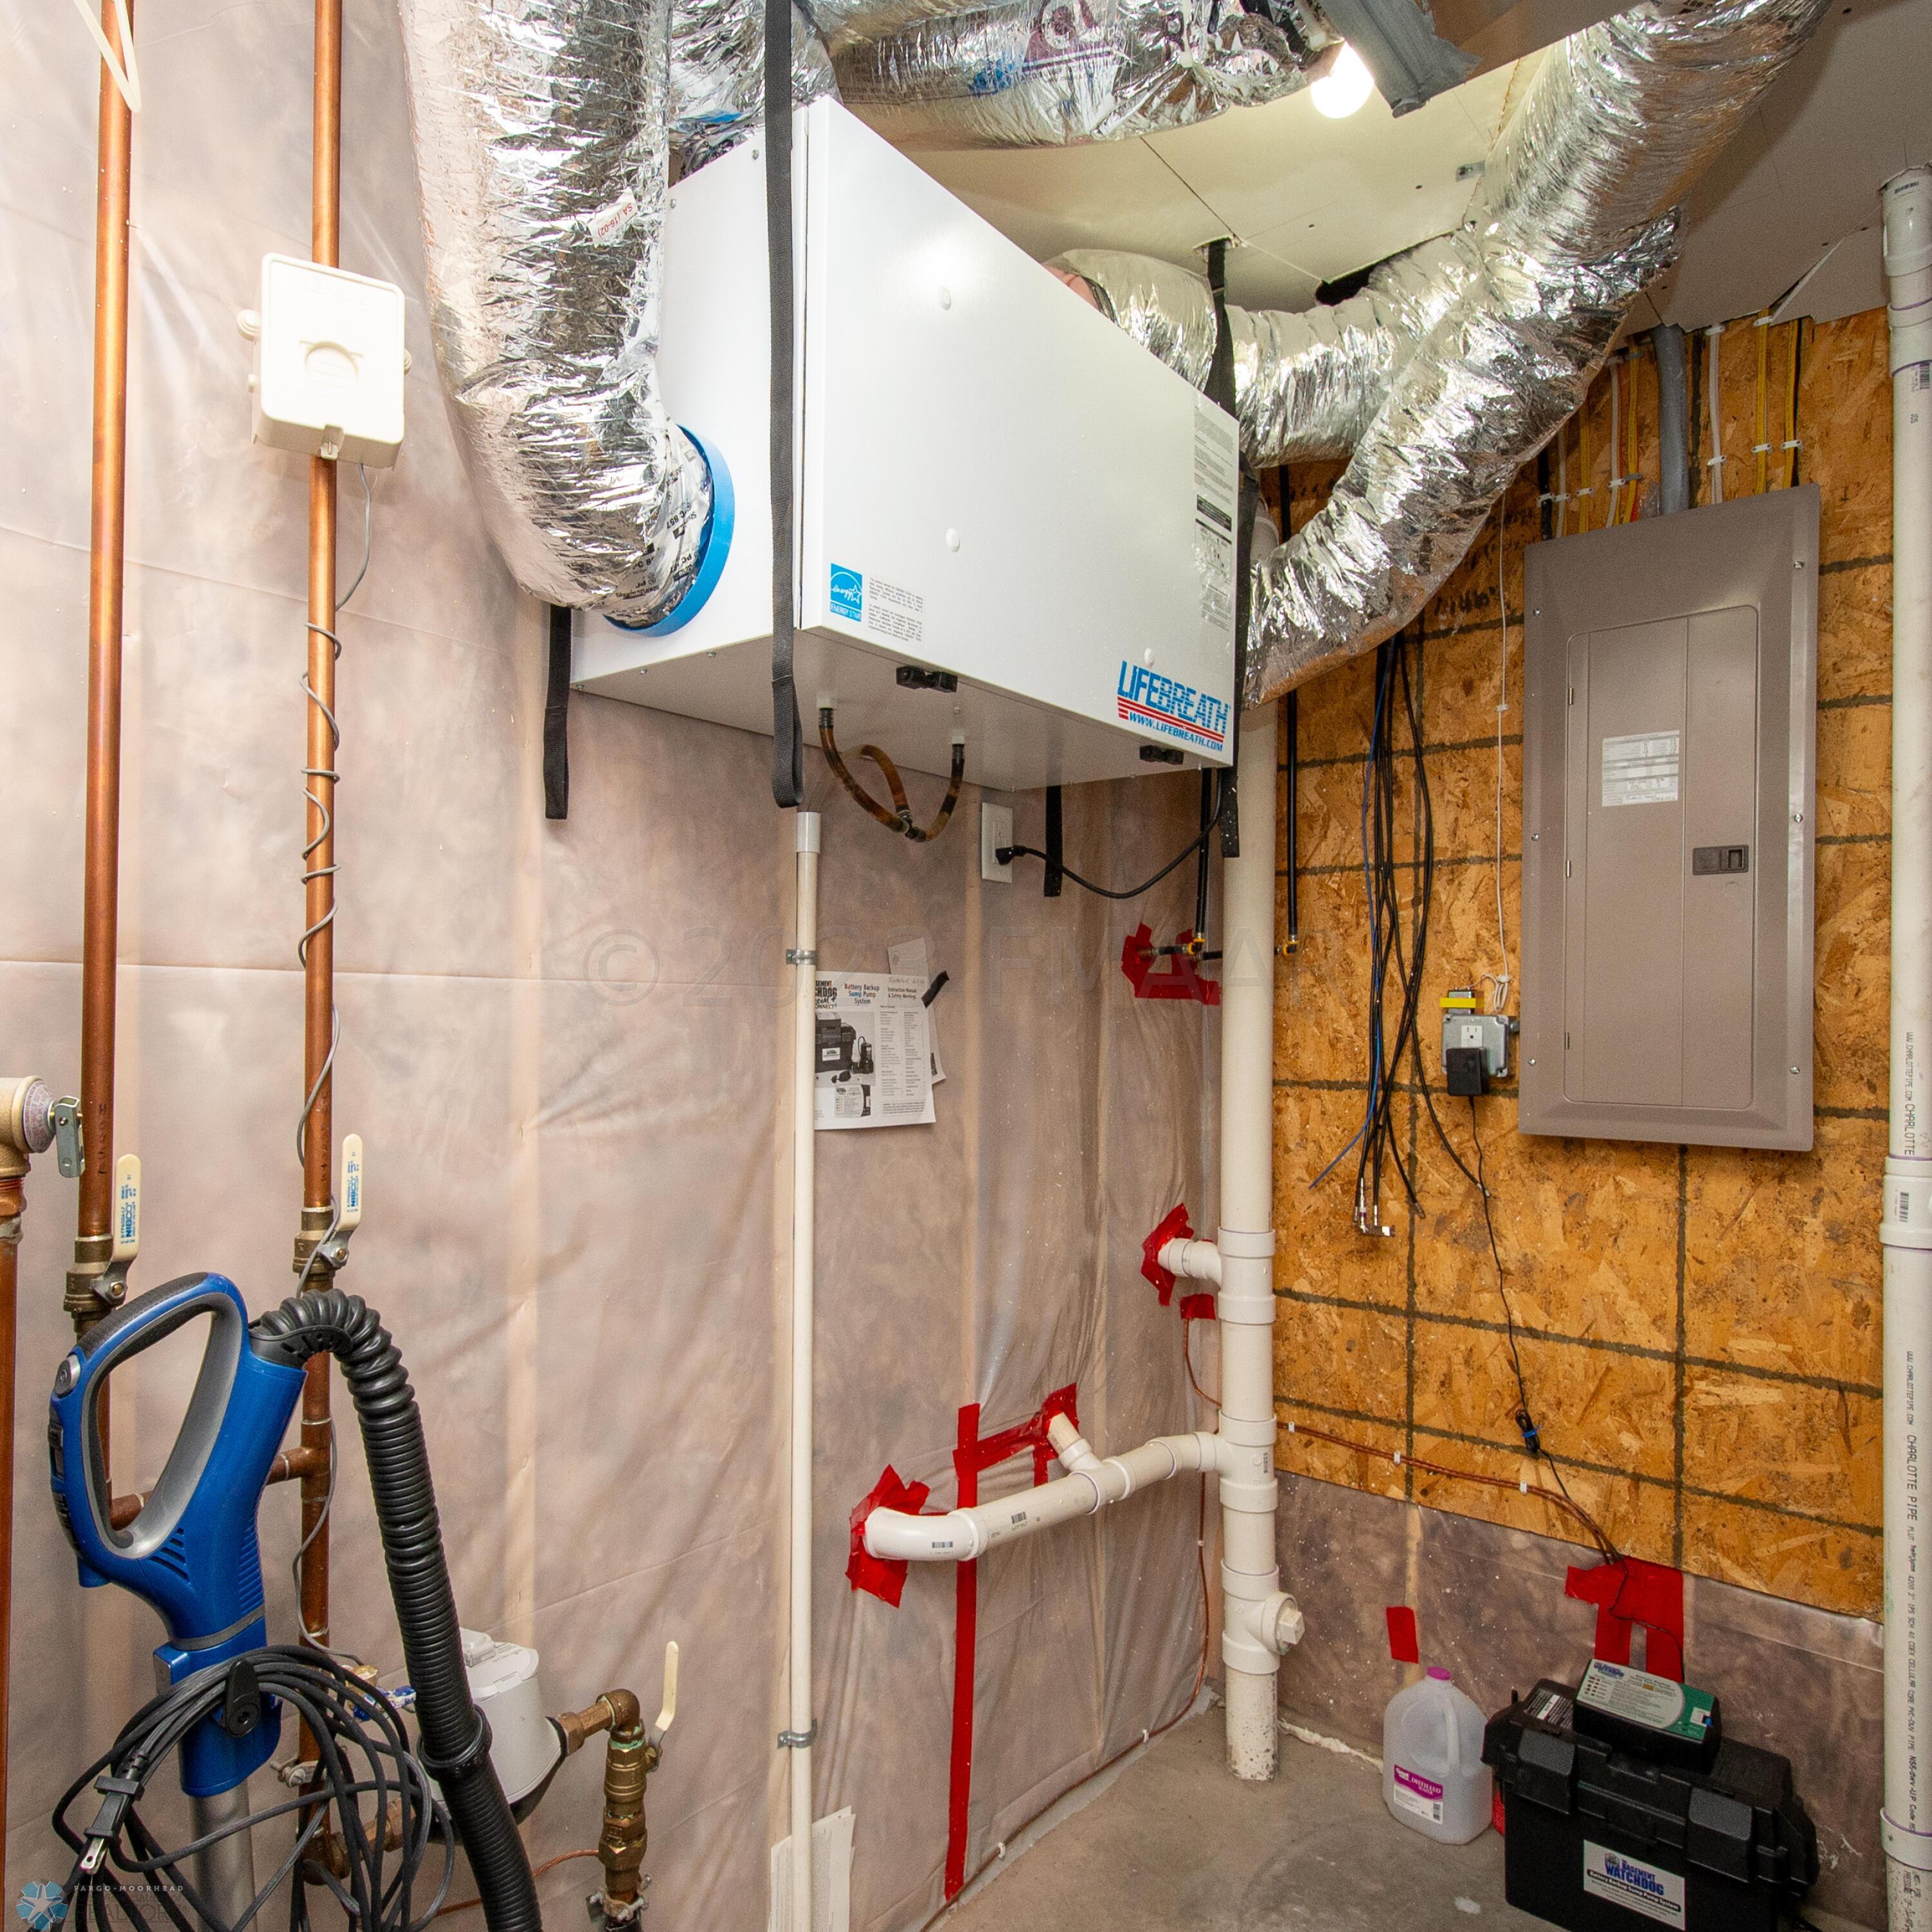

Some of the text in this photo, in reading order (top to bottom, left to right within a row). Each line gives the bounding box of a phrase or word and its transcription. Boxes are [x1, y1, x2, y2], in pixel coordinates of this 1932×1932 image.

[831, 603, 862, 620] ENERGY STAR
[1117, 660, 1229, 734] LIFEBREATH
[844, 983, 862, 991] Battery
[1904, 1103, 1916, 1156] CHARLOTTE
[1907, 1434, 1917, 1491] CHARLOTTE
[1908, 1495, 1917, 1522] PIPE
[1412, 1777, 1441, 1794] DISTILLED
[1605, 1863, 1664, 1896] WATCHDOG
[1622, 1859, 1656, 1880] BASEMENT
[1589, 1871, 1680, 1910] Battery Backup Sump Pump System
